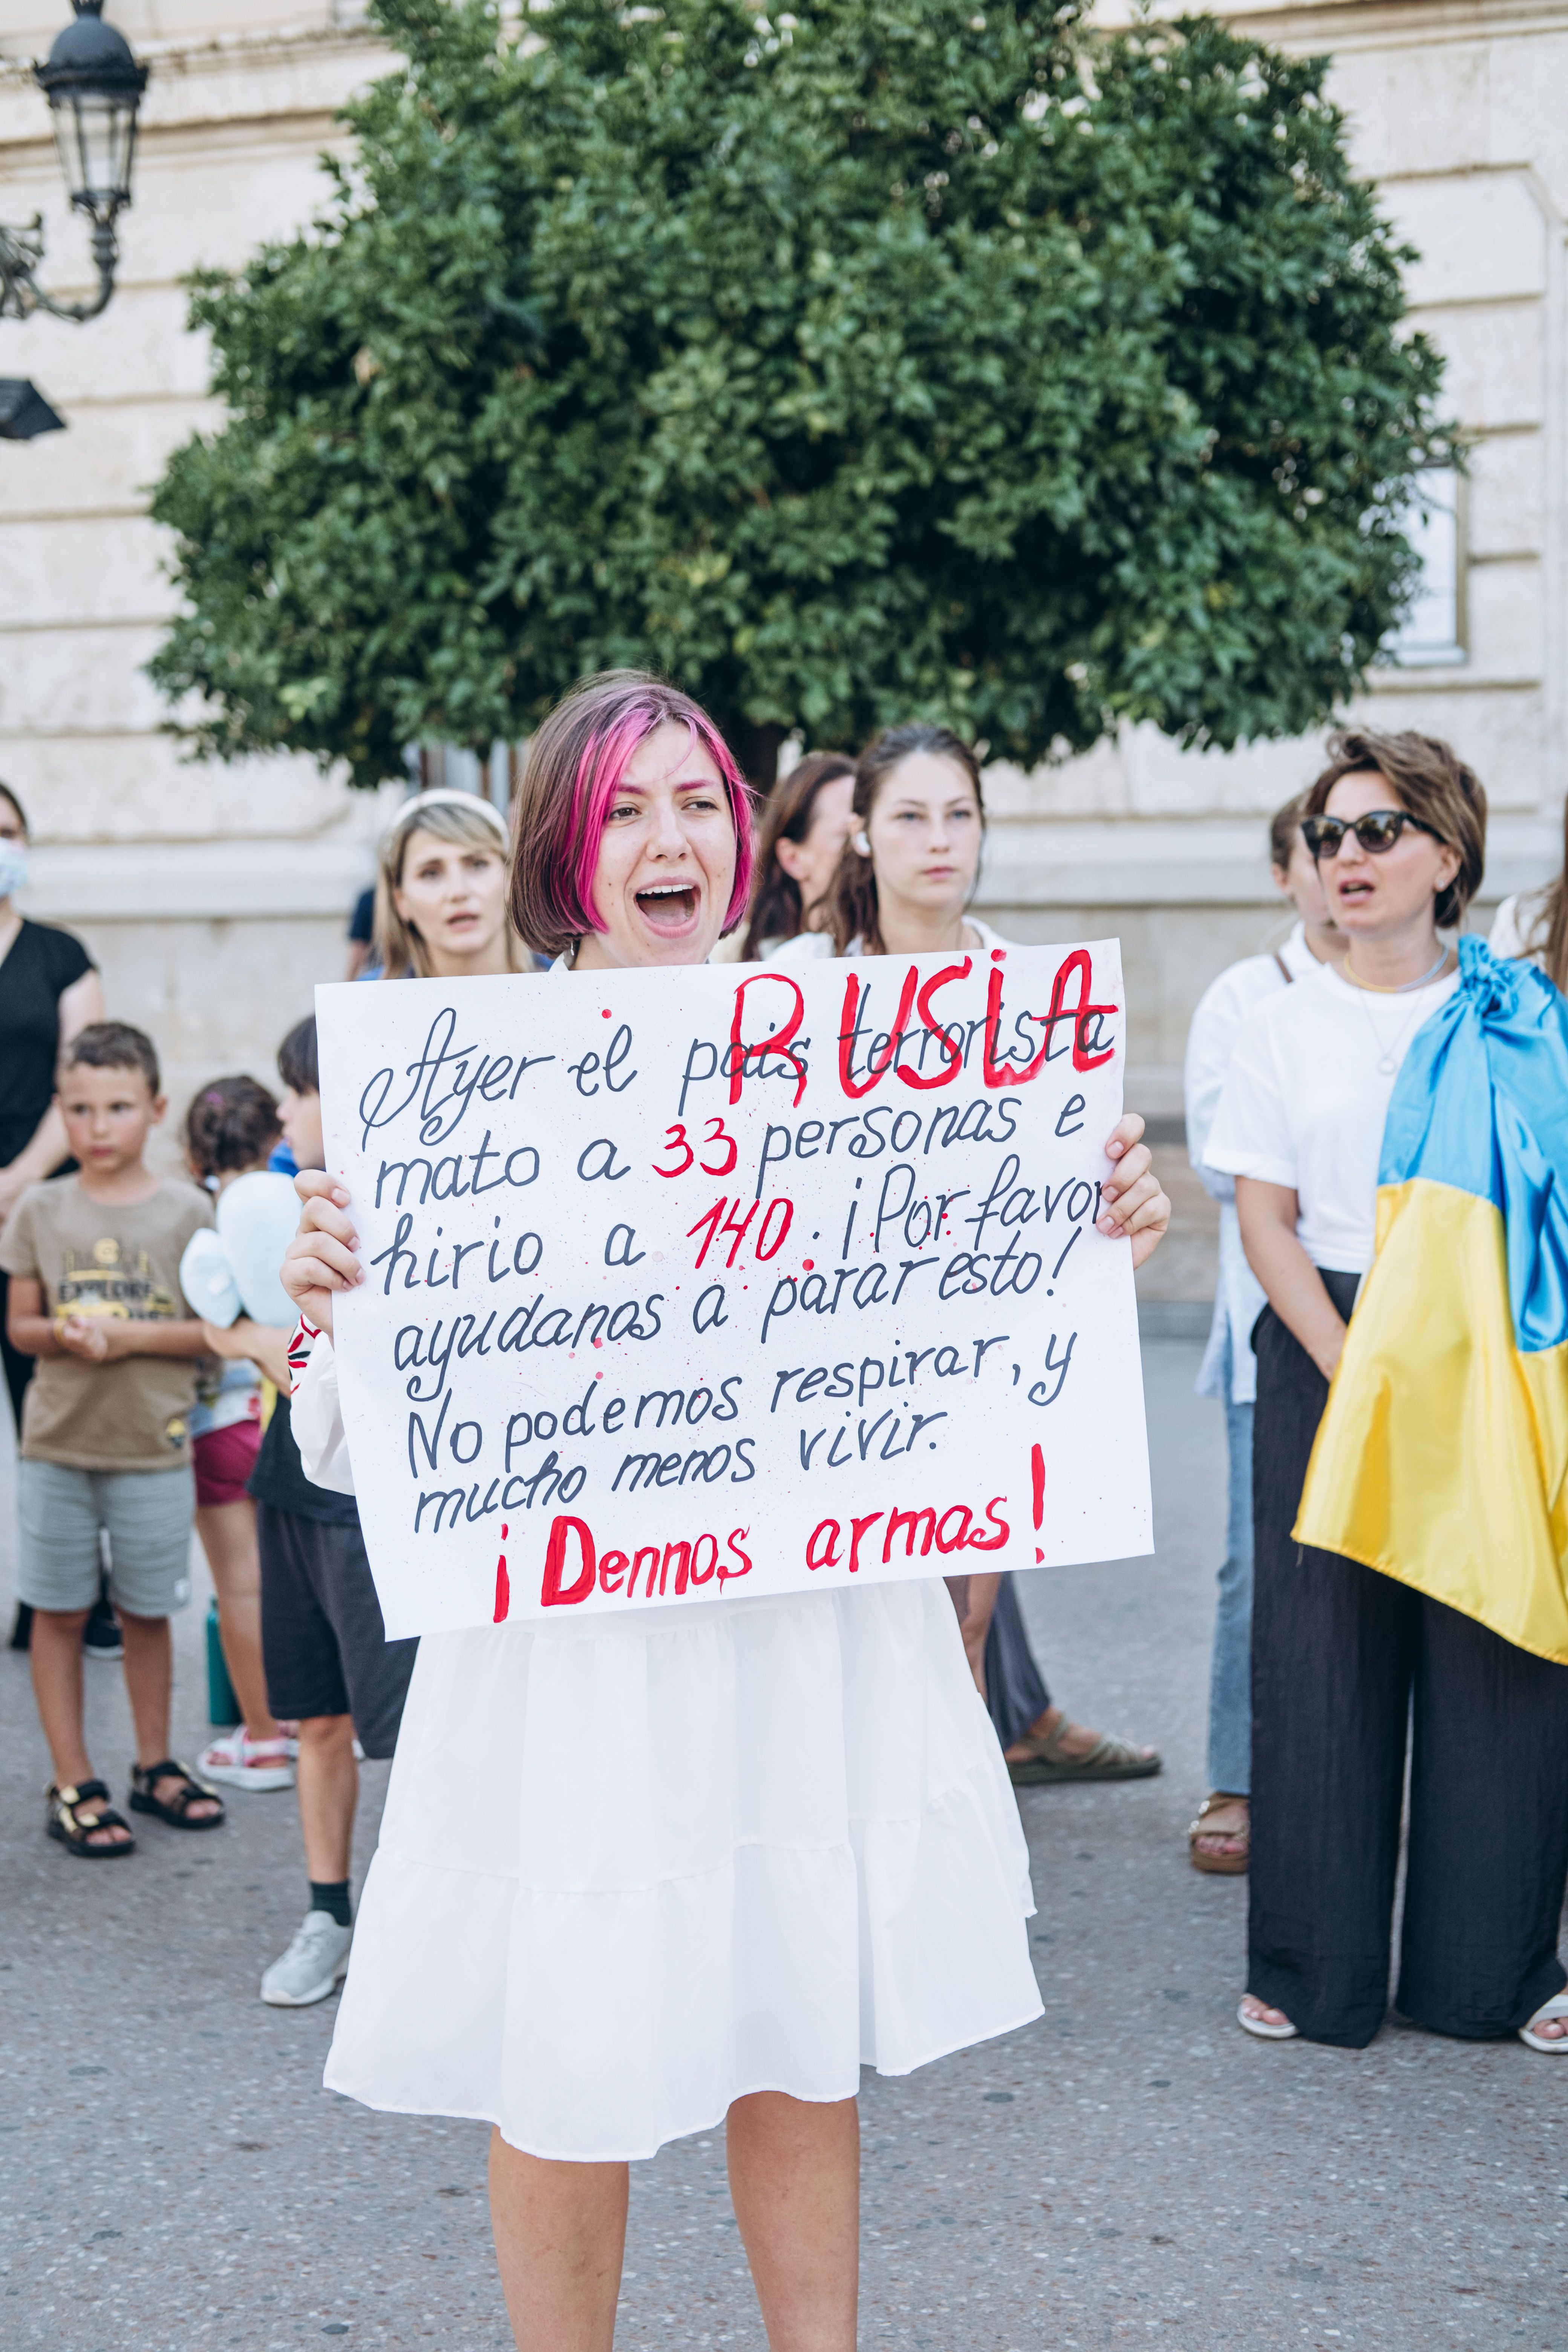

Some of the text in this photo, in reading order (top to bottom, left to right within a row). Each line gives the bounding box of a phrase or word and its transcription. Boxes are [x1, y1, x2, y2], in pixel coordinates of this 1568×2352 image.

[360, 1008, 556, 1152] Ayer
[568, 1024, 638, 1096] el
[837, 983, 1114, 1079] terrorista
[375, 1094, 1086, 1208] mato a 33 personas e
[371, 1213, 543, 1295] hirio
[604, 1223, 646, 1266] a
[394, 1227, 1082, 1401] ayudanos a parar esto!
[409, 1388, 482, 1478] No
[505, 1377, 742, 1473] podemos
[1028, 1332, 1078, 1406] y
[415, 1401, 948, 1534] mucho menos vivir.
[806, 1443, 1045, 1573] armas!
